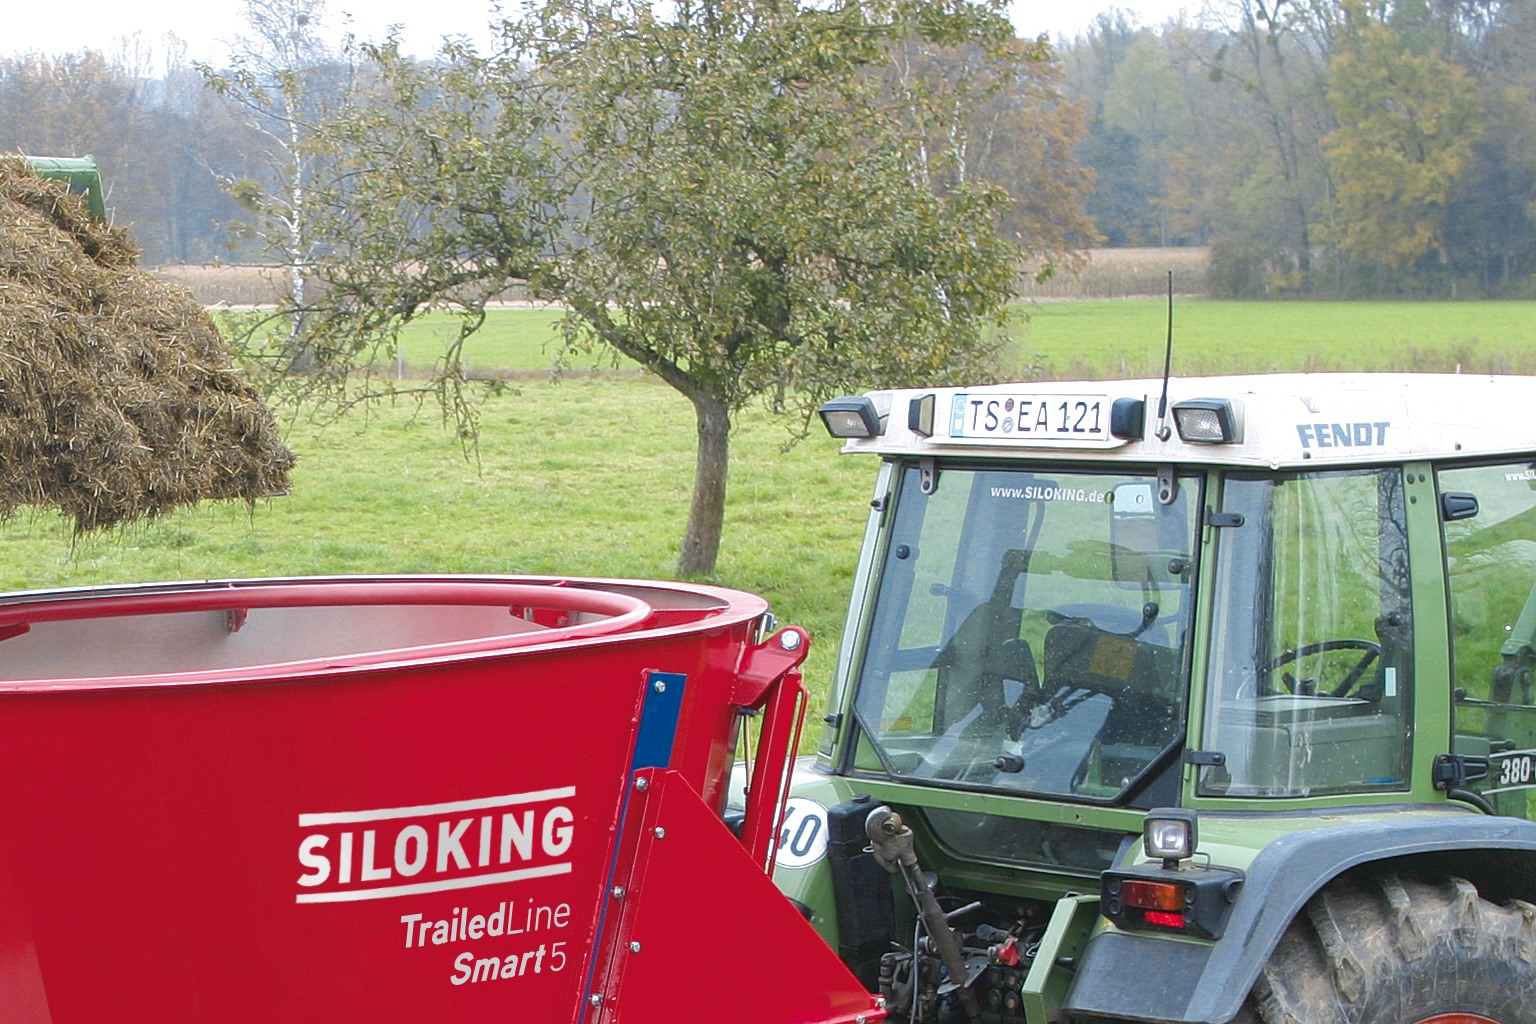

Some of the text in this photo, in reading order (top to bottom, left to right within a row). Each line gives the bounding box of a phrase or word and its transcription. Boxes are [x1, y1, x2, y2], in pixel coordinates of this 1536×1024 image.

[970, 400, 1102, 433] TS EA 121
[1295, 422, 1390, 448] FENDT
[990, 486, 1105, 503] www.SILOKING.de
[1500, 756, 1531, 785] 380
[296, 805, 575, 887] SILOKING
[400, 898, 571, 949] TrailedLine
[450, 942, 567, 986] Smart 5
